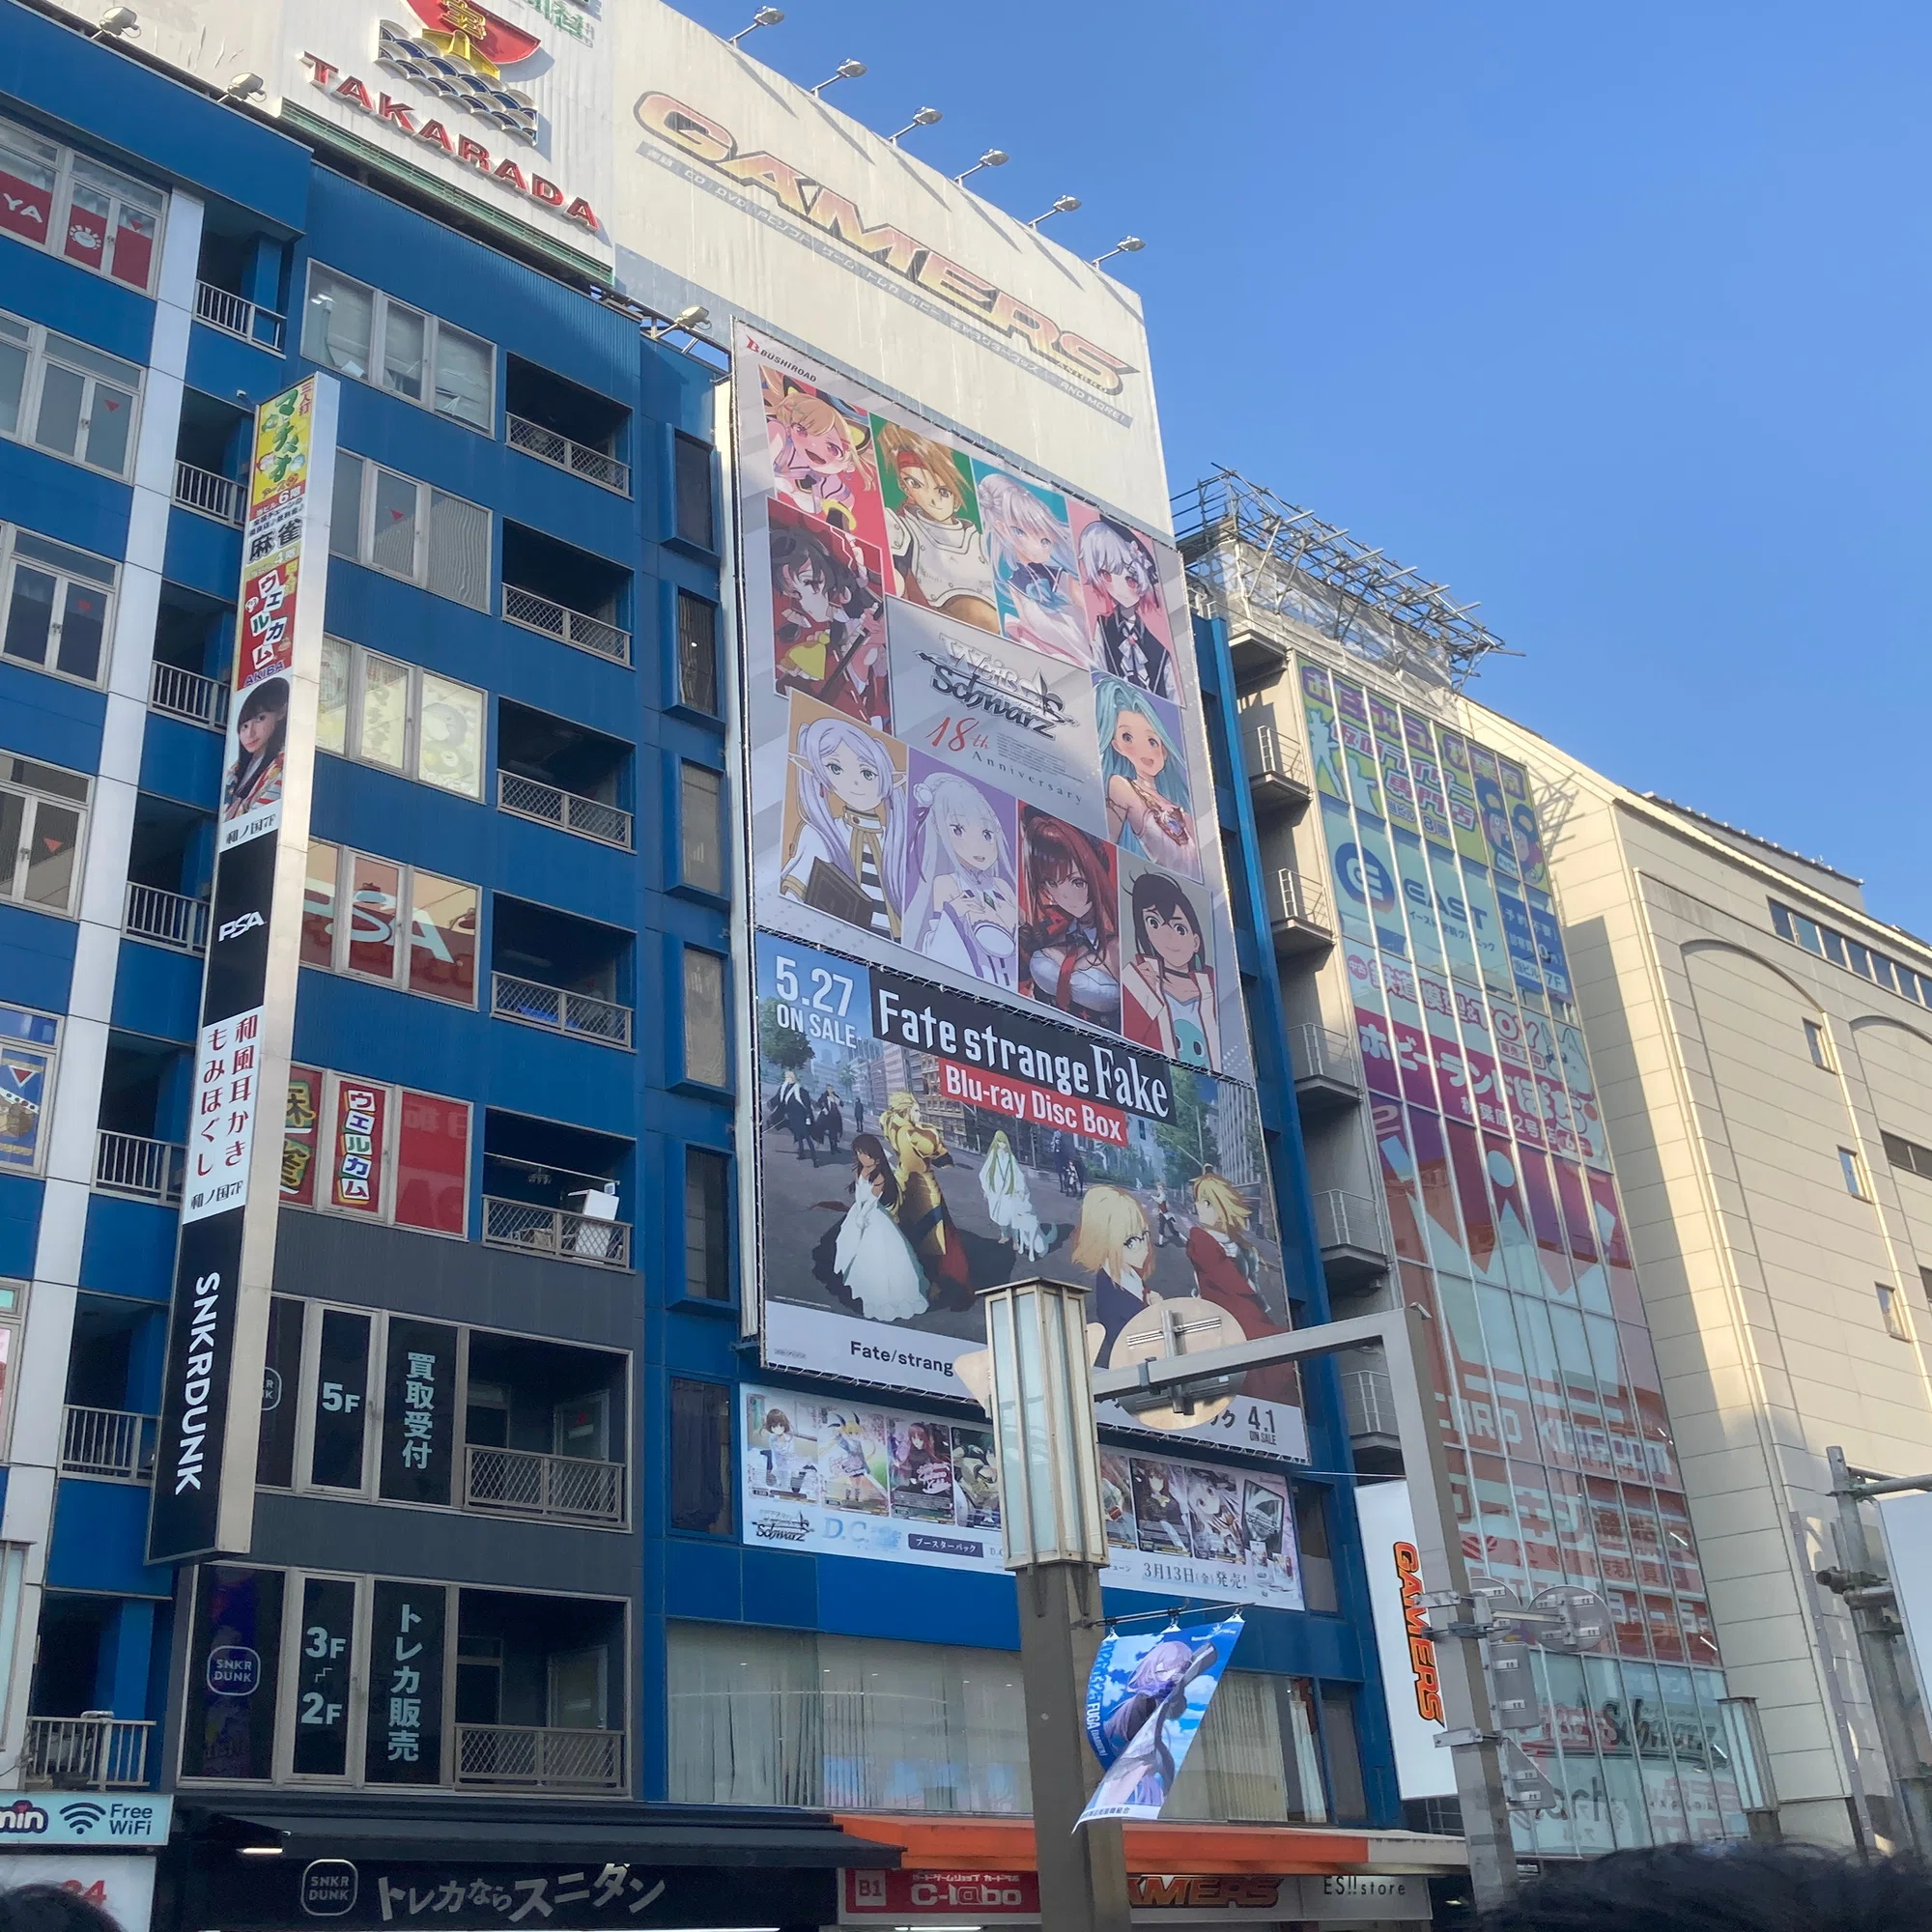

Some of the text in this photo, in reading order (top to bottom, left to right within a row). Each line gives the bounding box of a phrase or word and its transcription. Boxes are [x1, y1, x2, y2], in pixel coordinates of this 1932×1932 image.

[298, 51, 600, 232] TAKARADA
[633, 90, 1141, 394] GAMERS
[684, 170, 705, 185] CD
[715, 186, 747, 209] DVD
[822, 245, 856, 271] ゲーム
[1061, 381, 1085, 398] AND
[1087, 396, 1124, 421] MORE!
[760, 350, 817, 383] BUSHIROAD
[247, 518, 302, 564] 麻雀
[243, 660, 286, 688] AKIBA
[932, 666, 1057, 741] Schwarz
[925, 717, 990, 753] 18th
[972, 751, 1083, 805] Anniversary
[1387, 771, 1477, 831] 専門店
[1404, 877, 1488, 931] EAST
[218, 911, 266, 942] PSA
[776, 955, 854, 1018] 5.27
[1544, 971, 1563, 990] 7F
[776, 1003, 857, 1050] ON SALE
[878, 989, 1171, 1118] Fate strange Fake
[198, 1027, 228, 1177] もみほぐし
[225, 1013, 259, 1167] 和風耳かき
[945, 1065, 1123, 1143] Blu-ray Disc Box
[190, 1179, 244, 1210] 和ノ国7F
[850, 1340, 954, 1378] Fate/strang
[175, 1271, 221, 1495] SNKRDUNK
[322, 1382, 360, 1414] 5F
[402, 1351, 436, 1471] 買取受付
[1248, 1406, 1276, 1435] 4.1
[1249, 1431, 1277, 1446] ON SALE
[915, 1537, 977, 1553] ブースターパック
[305, 1626, 346, 1660] 3F
[1393, 1540, 1446, 1729] GAMERS
[213, 1670, 252, 1684] DUNK
[216, 1658, 252, 1673] SNKR
[387, 1604, 423, 1763] トレカ販売
[301, 1691, 343, 1725] 2F
[1086, 1702, 1101, 1730] FUGA
[109, 1803, 154, 1819] Free
[109, 1820, 152, 1835] WiFi
[308, 1889, 349, 1902] DUNK
[310, 1875, 350, 1888] SNKR
[378, 1862, 666, 1923] トレカならスニダン
[858, 1879, 883, 1897] B1
